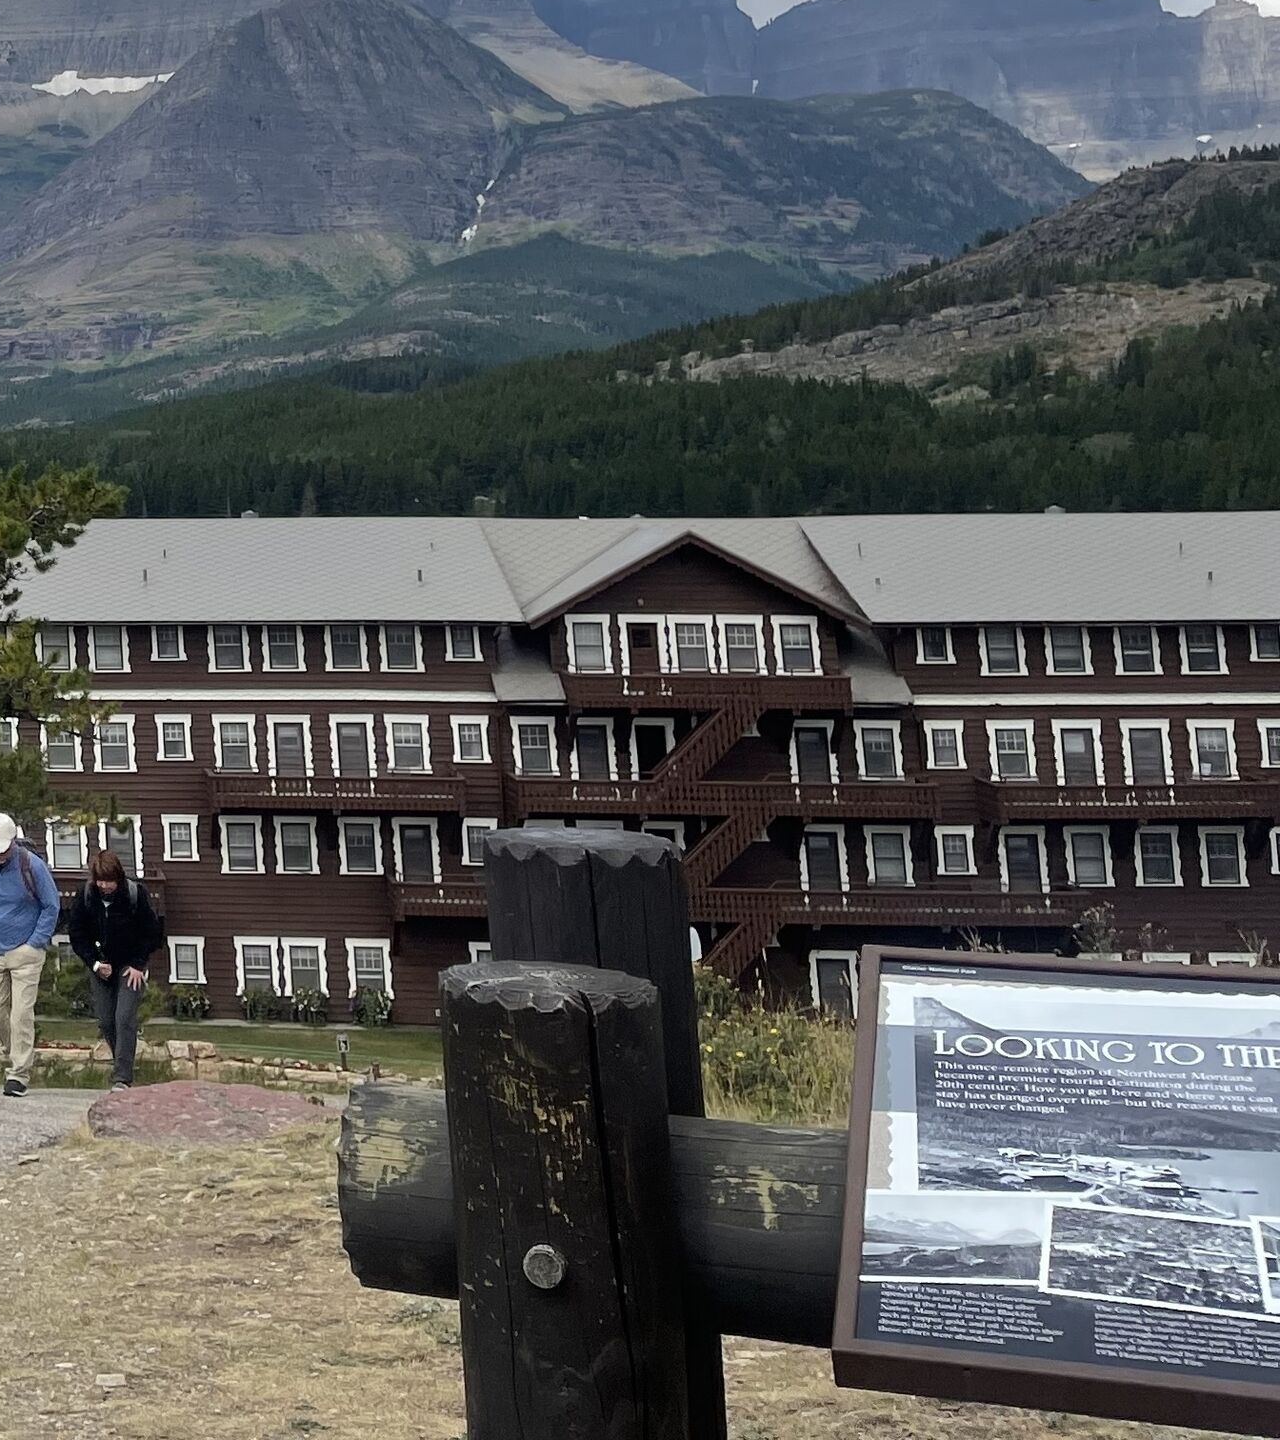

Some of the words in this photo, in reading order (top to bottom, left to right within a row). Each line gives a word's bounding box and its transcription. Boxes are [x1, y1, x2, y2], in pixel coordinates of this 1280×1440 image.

[933, 1029, 1136, 1063] LOOKING
[1148, 1041, 1205, 1066] TO
[934, 1061, 964, 1070] This
[1053, 1067, 1095, 1076] region
[1098, 1068, 1112, 1076] of
[1116, 1069, 1186, 1079] Northwest
[1191, 1072, 1254, 1082] Montana
[934, 1070, 985, 1080] became
[998, 1075, 1057, 1084] premiere
[1060, 1077, 1104, 1086] tourist
[1107, 1078, 1182, 1089] destination
[1185, 1082, 1232, 1092] during
[1234, 1084, 1257, 1092] the
[935, 1080, 964, 1089] 20th
[1024, 1083, 1057, 1093] How
[1059, 1088, 1085, 1096] you
[1088, 1088, 1108, 1097] get
[1111, 1088, 1141, 1097] here
[1144, 1090, 1170, 1099] and
[1173, 1091, 1216, 1101] where
[1218, 1095, 1245, 1103] you
[935, 1091, 960, 1100] stay
[964, 1090, 987, 1100] has
[989, 1092, 1045, 1103] changed
[1047, 1096, 1078, 1104] over
[1150, 1100, 1173, 1109] the
[1176, 1102, 1229, 1111] reasons
[1231, 1104, 1247, 1112] to
[935, 1099, 966, 1109] have
[969, 1102, 1007, 1110] never
